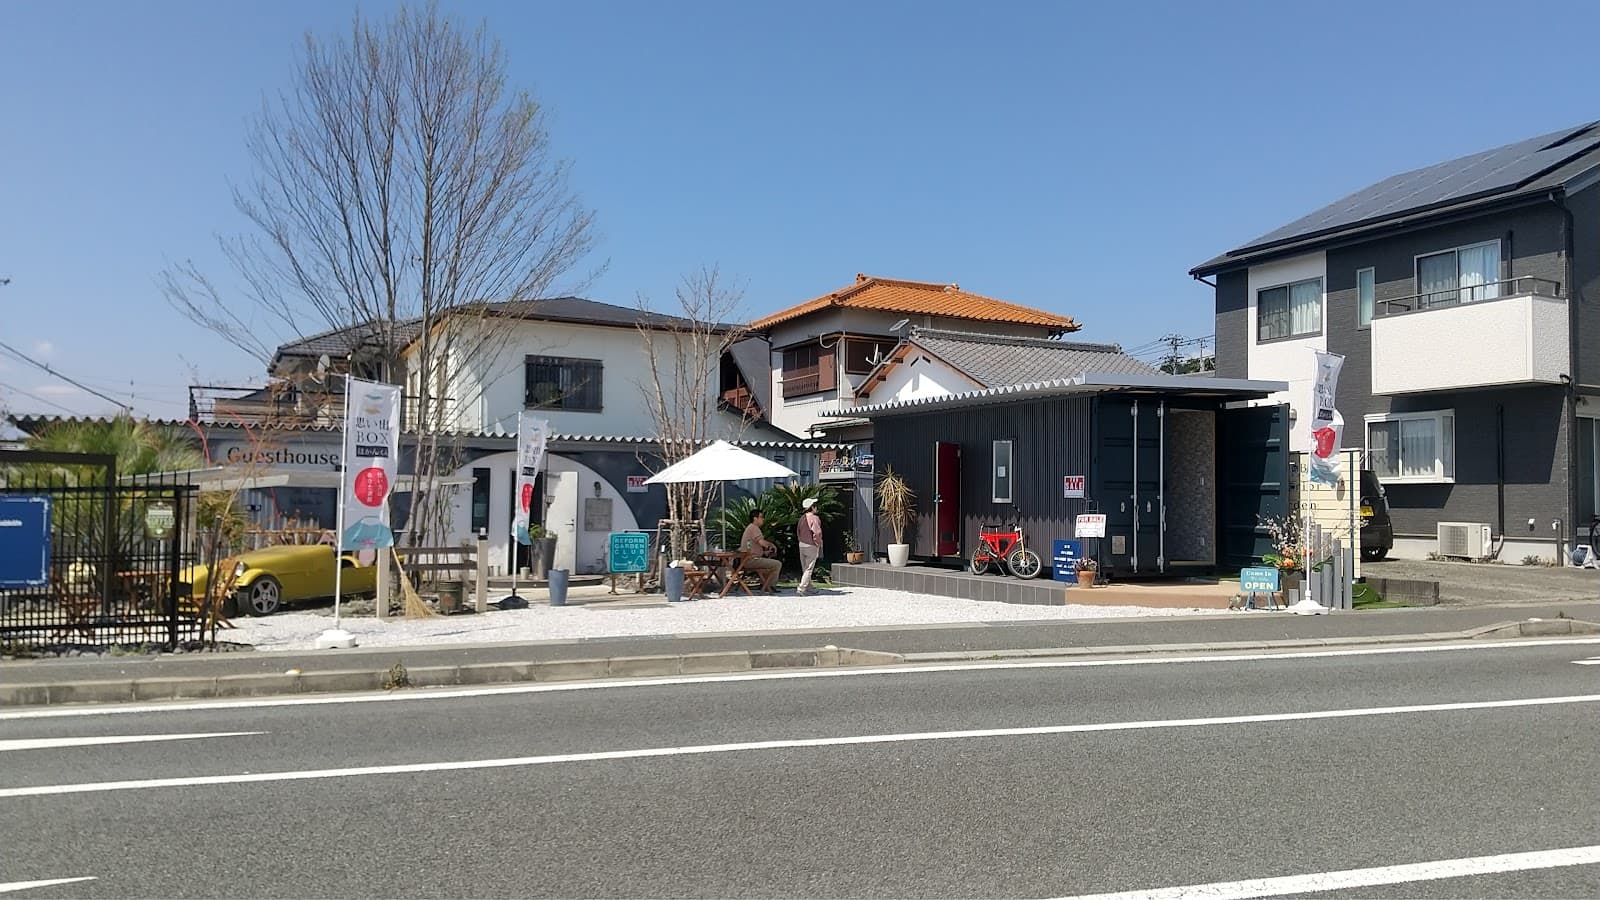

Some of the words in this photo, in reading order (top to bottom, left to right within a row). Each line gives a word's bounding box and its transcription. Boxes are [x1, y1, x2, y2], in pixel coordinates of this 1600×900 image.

[357, 430, 389, 445] BOX
[227, 446, 339, 466] Guesthouse
[1065, 482, 1083, 490] SALE
[1244, 581, 1275, 590] OPEN
